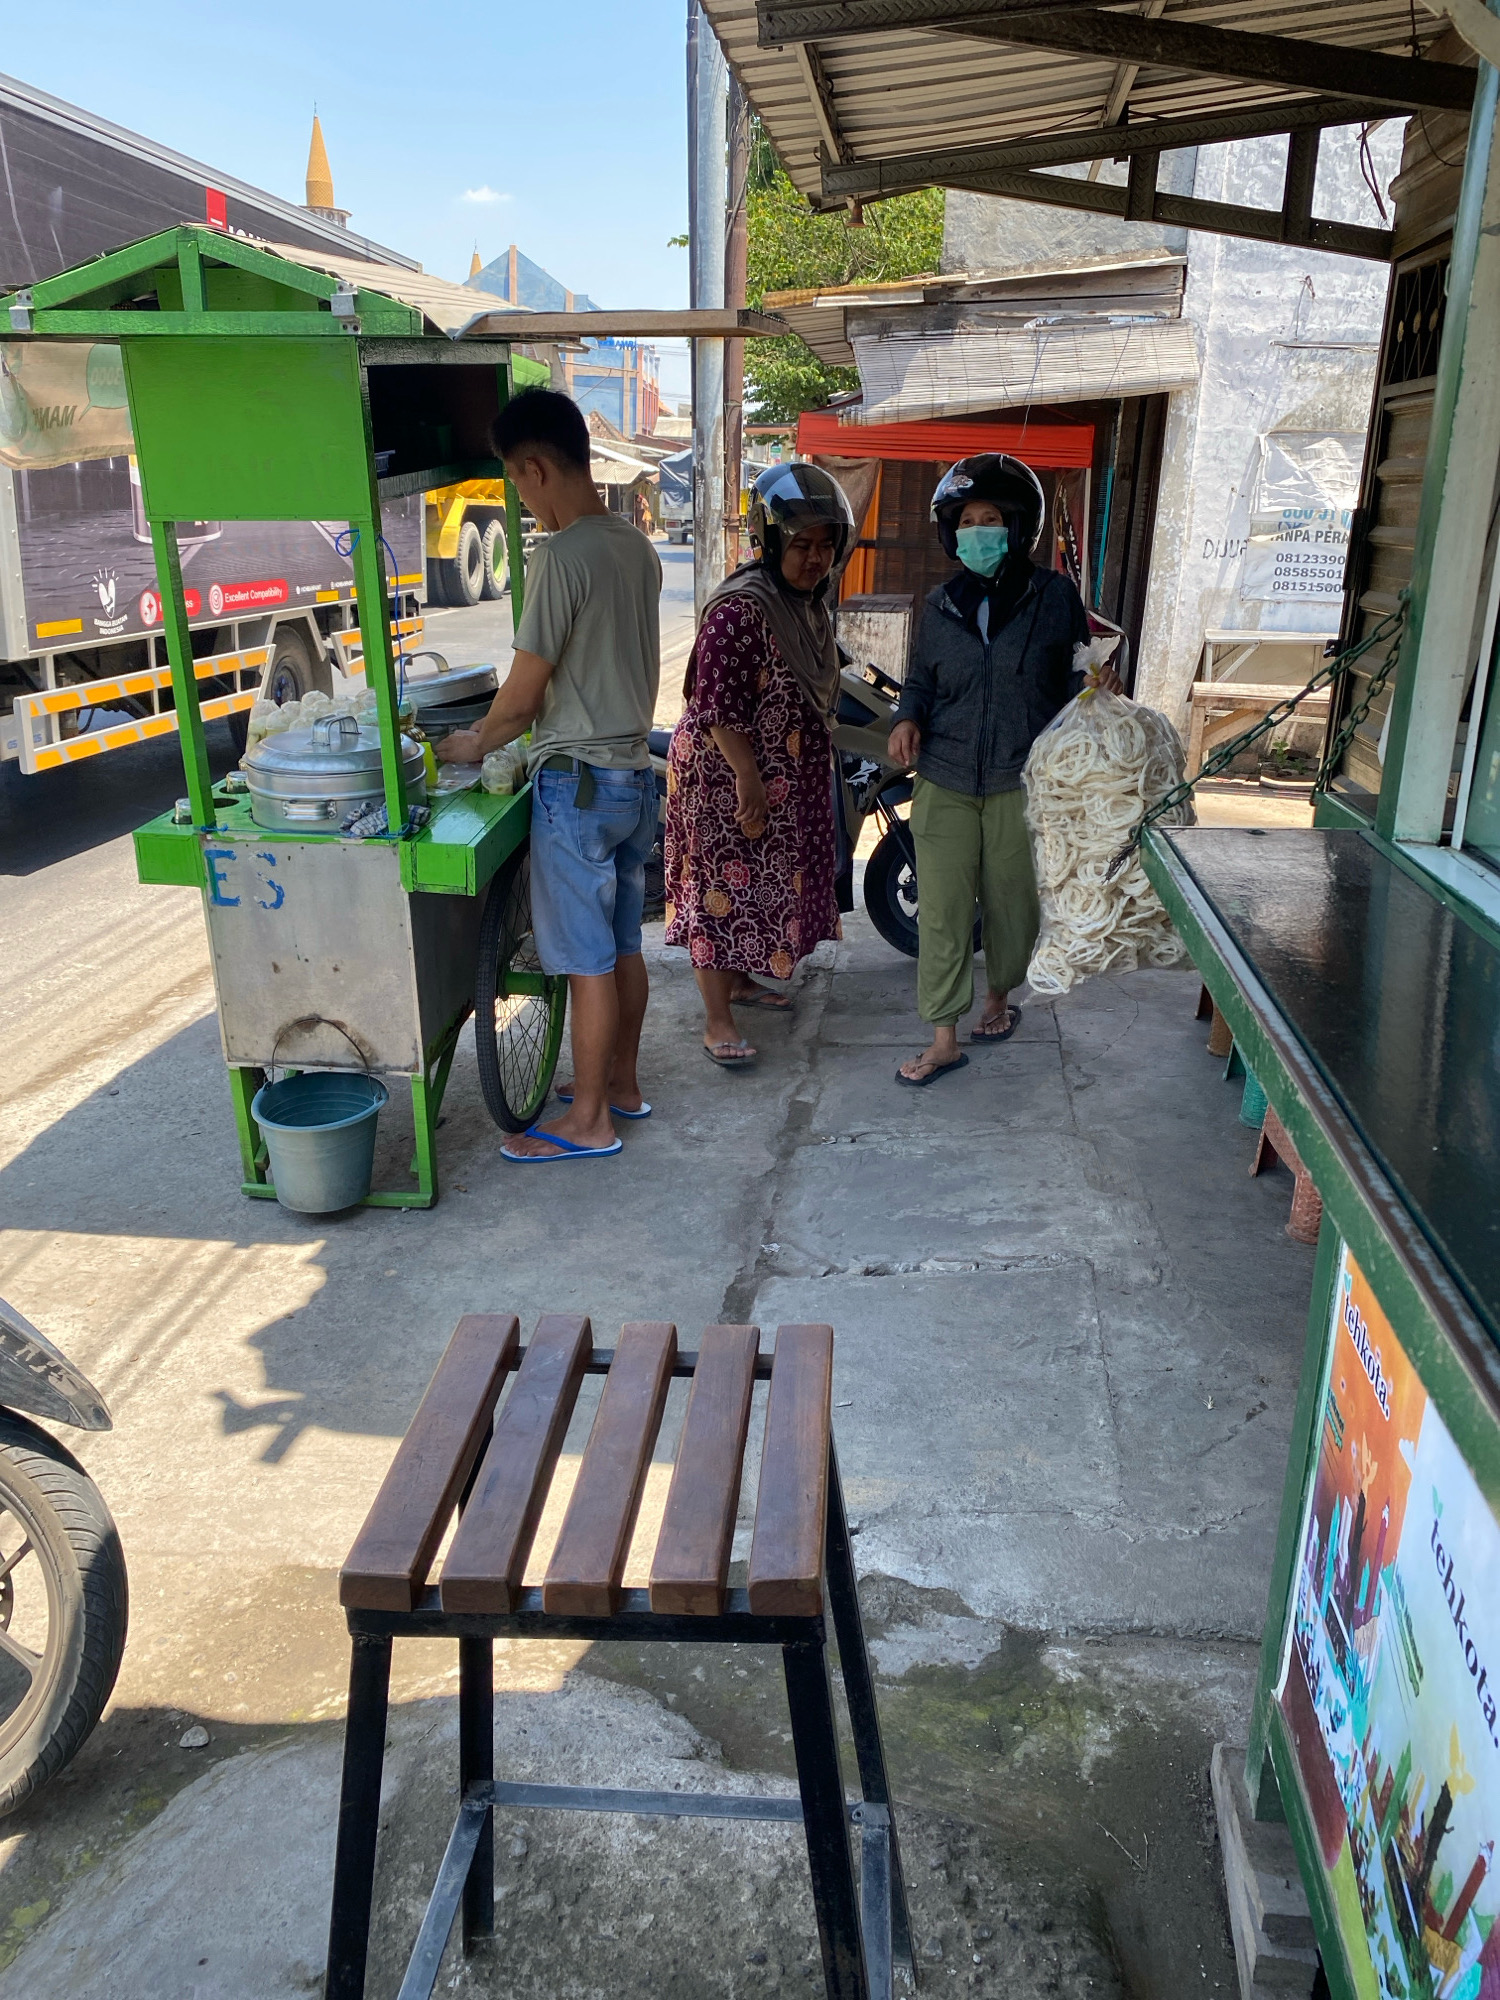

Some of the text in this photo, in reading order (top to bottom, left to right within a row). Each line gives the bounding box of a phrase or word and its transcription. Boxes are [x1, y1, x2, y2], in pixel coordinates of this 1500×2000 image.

[224, 591, 250, 603] Excellent
[250, 586, 283, 601] Compatibility
[204, 848, 285, 910] ES
